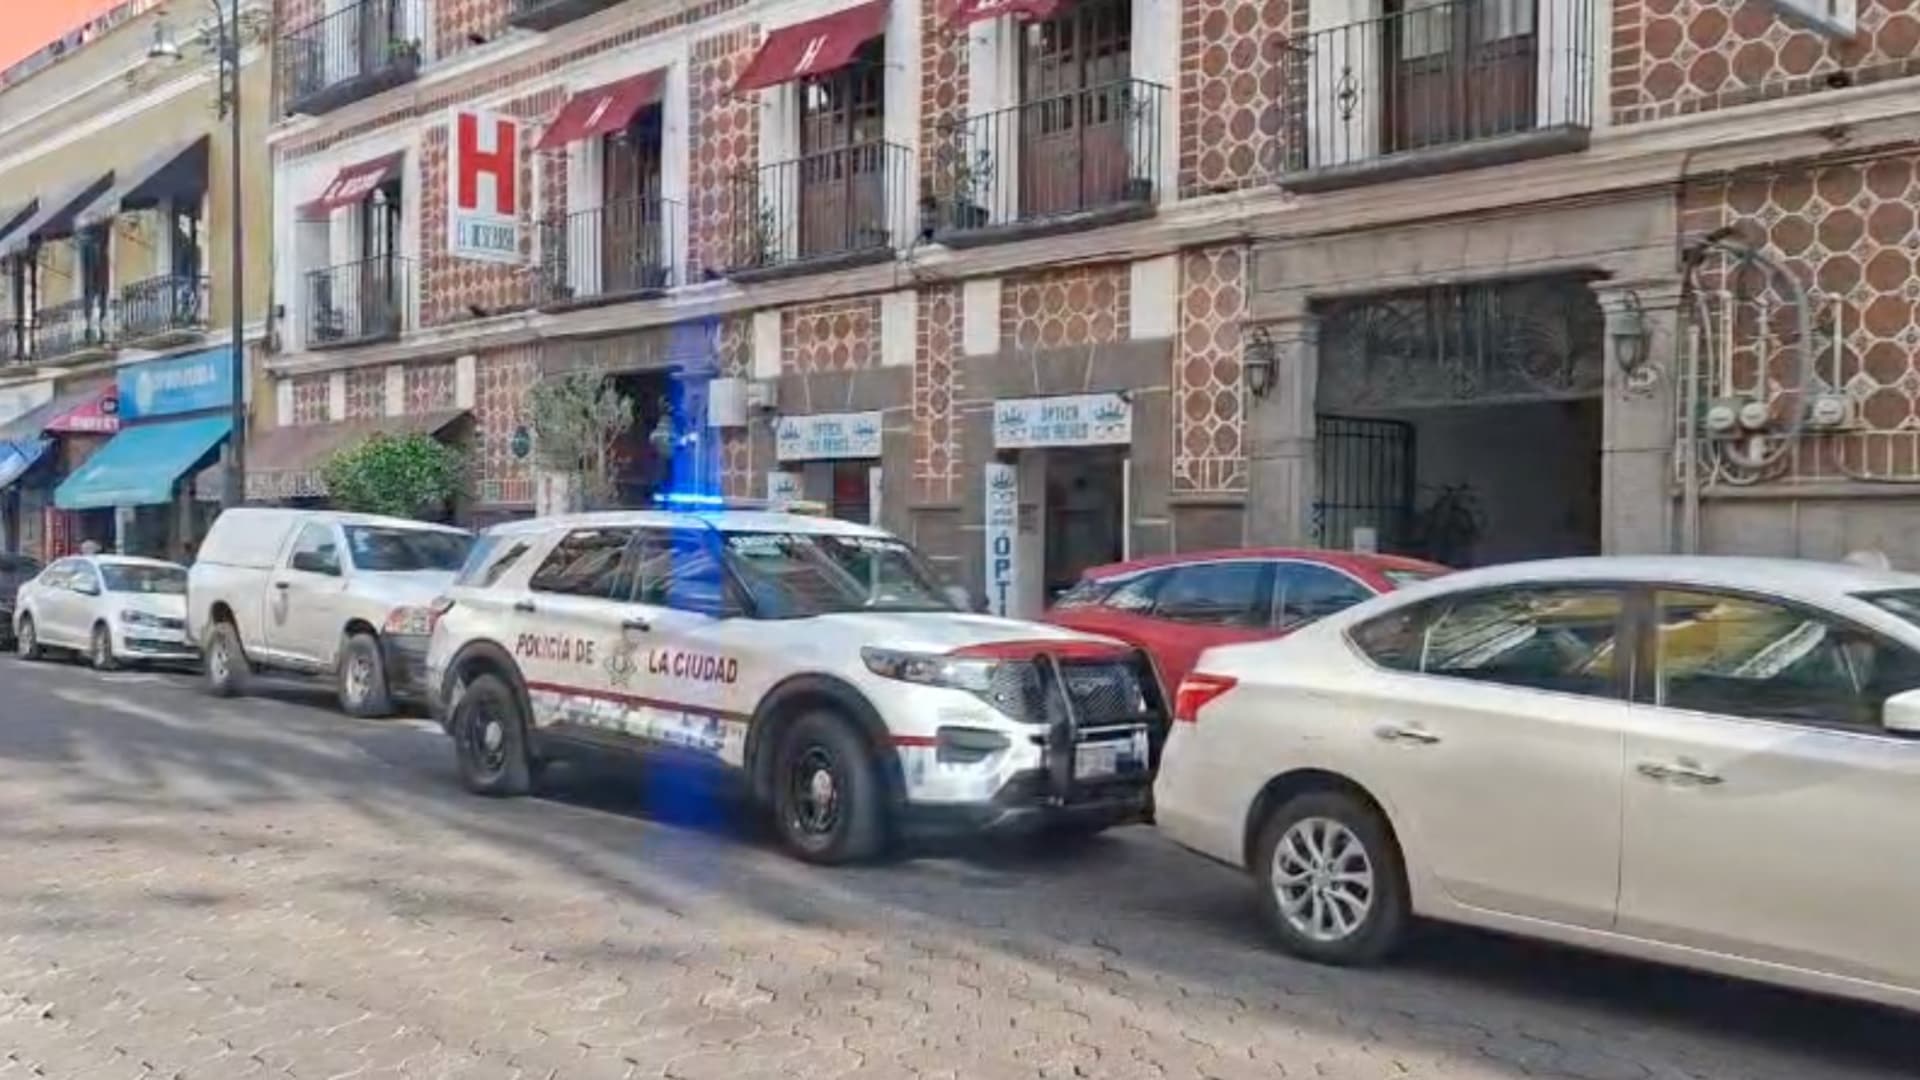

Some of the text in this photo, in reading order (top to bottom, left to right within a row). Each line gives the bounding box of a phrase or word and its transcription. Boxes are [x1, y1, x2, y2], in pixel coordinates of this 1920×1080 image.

[457, 112, 516, 215] H
[575, 637, 596, 665] DE
[648, 649, 669, 676] LA
[673, 651, 738, 684] CIUDAD
